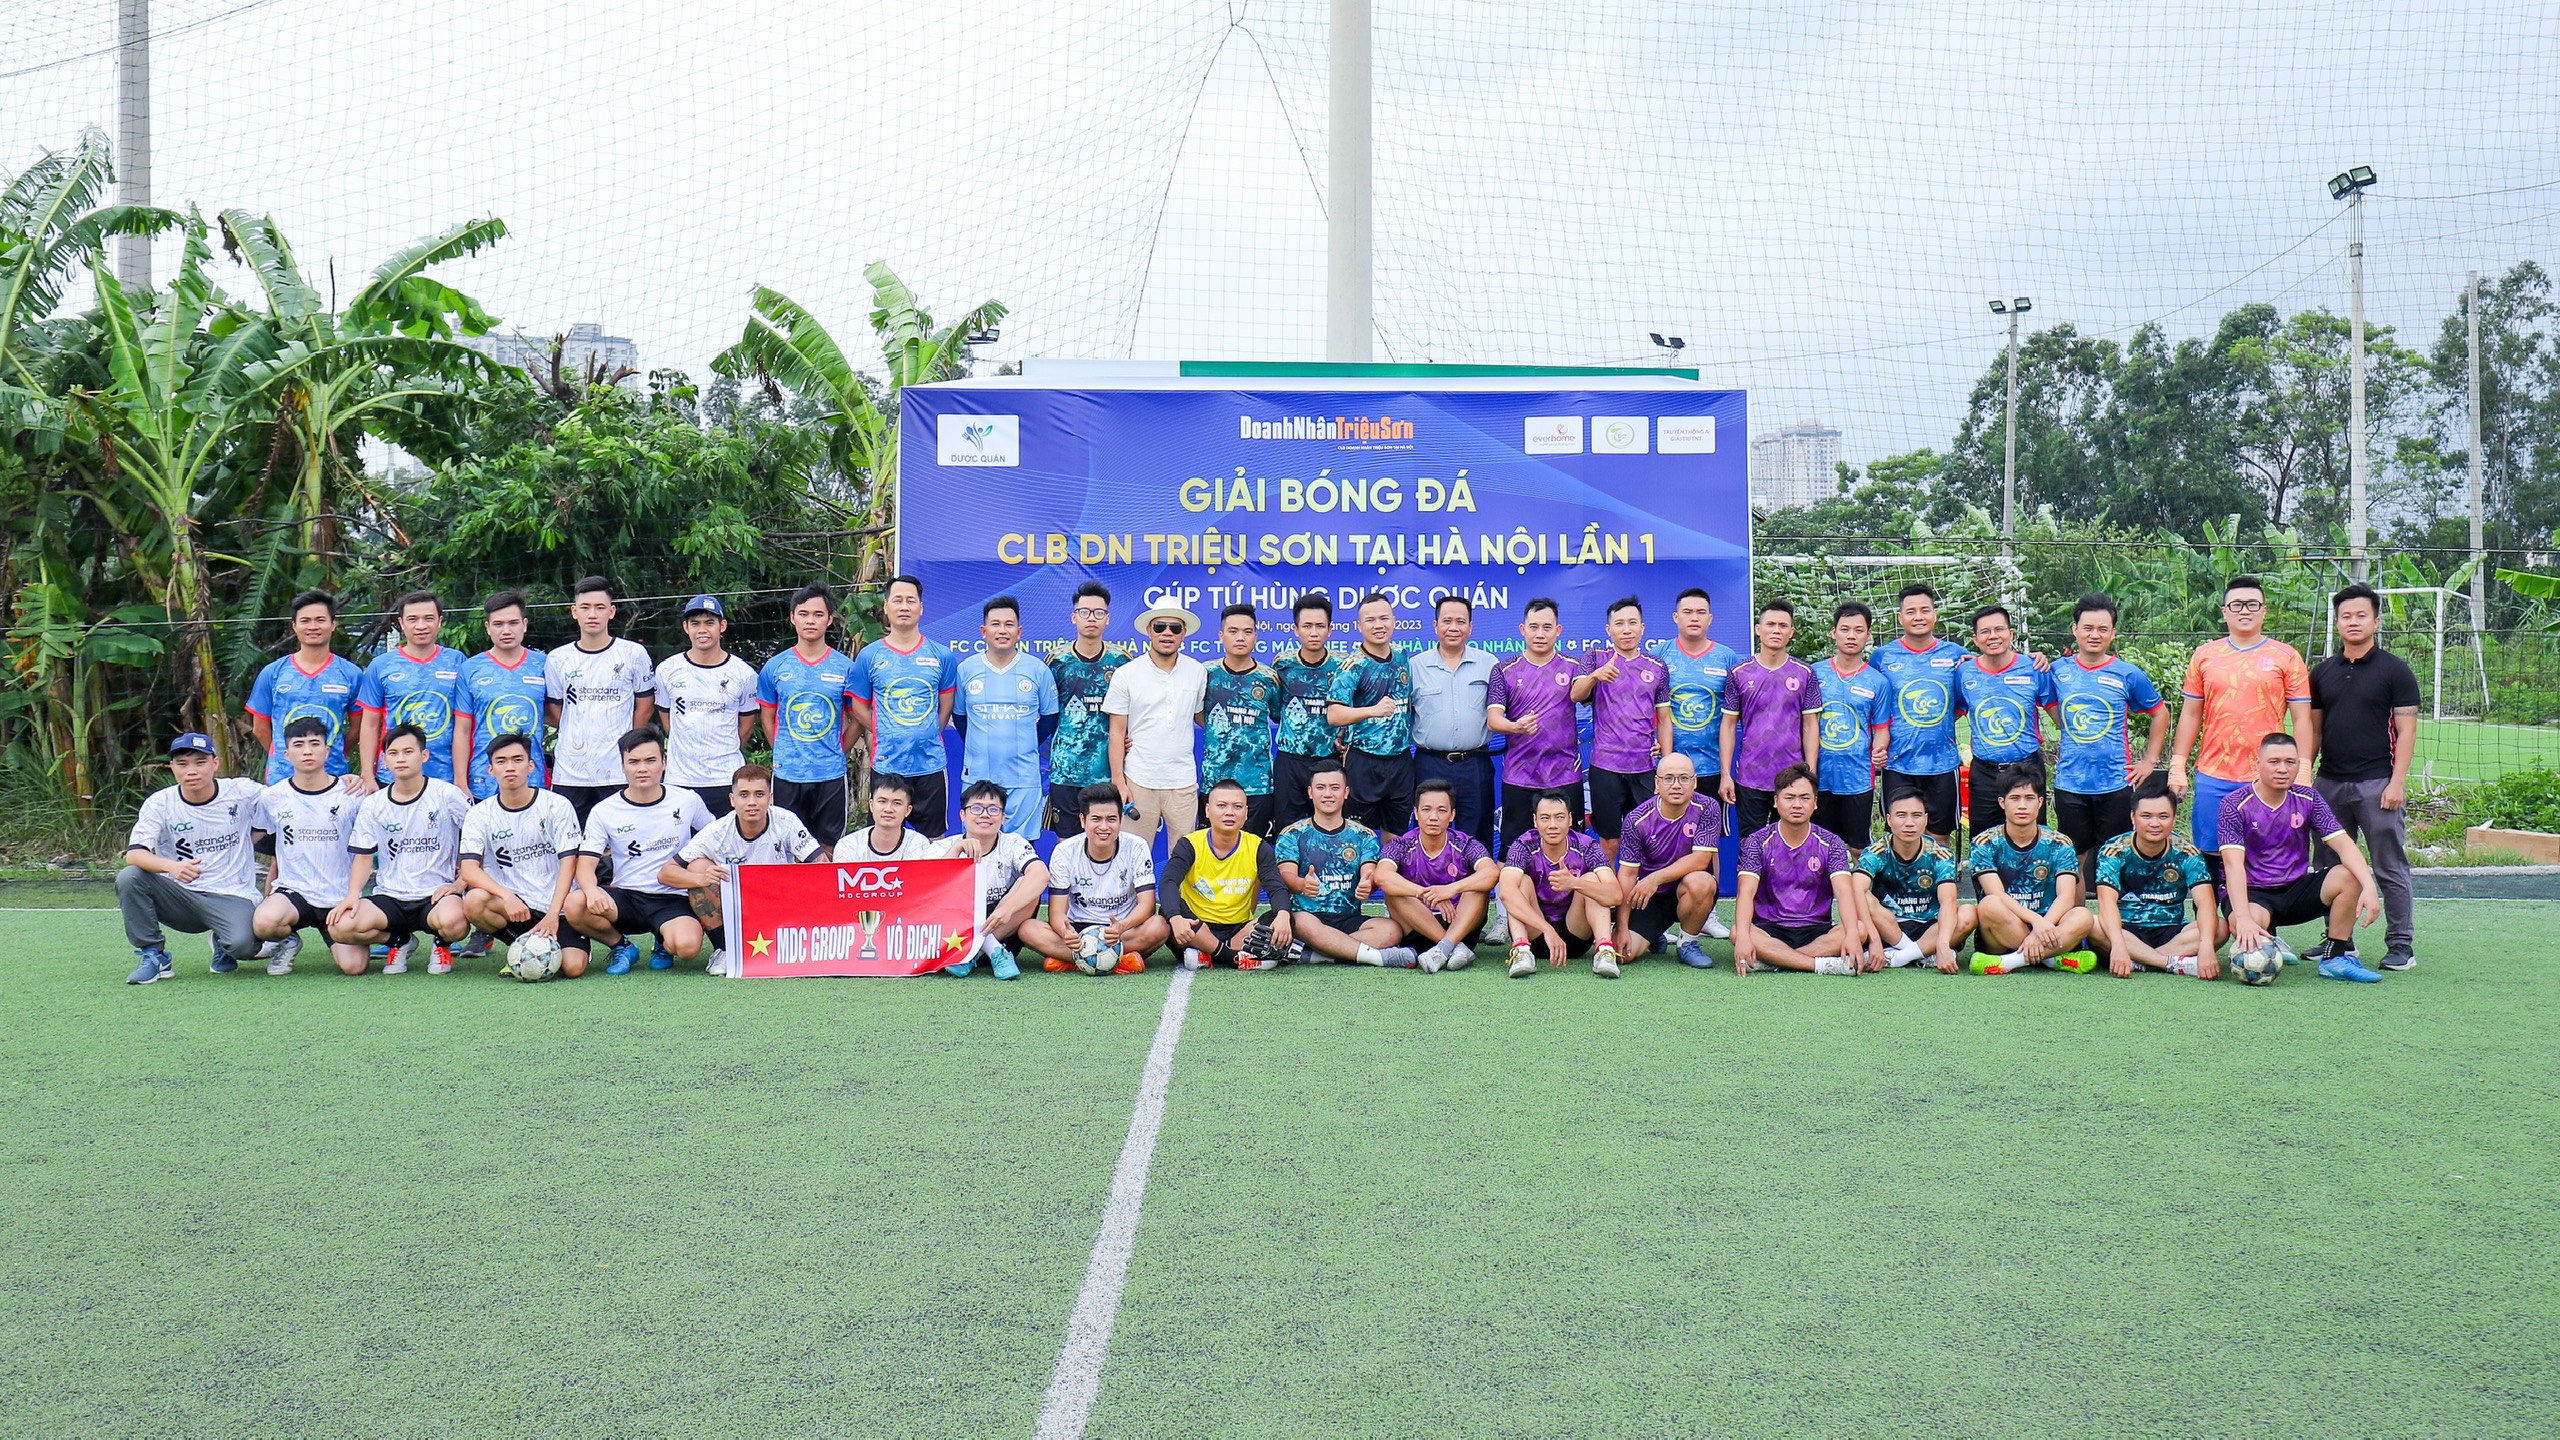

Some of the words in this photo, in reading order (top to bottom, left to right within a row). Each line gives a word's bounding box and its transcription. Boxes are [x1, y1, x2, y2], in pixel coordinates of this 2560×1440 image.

[1532, 434, 1576, 443] everhome
[1178, 466, 1267, 513] GIẢI
[1279, 468, 1403, 513] BÓNG
[1415, 468, 1478, 513] ĐÁ
[996, 532, 1068, 565] CLB
[1080, 532, 1133, 565] DN
[1143, 526, 1247, 576] TRIỆU
[1258, 531, 1338, 566] SƠN
[1348, 533, 1406, 575] TẠI
[1417, 526, 1469, 566] HÀ
[1480, 525, 1548, 576] NỘI
[1559, 521, 1629, 565] LẦN
[1639, 532, 1655, 565] 1
[1206, 580, 1245, 609] TỨ
[950, 640, 970, 653] FC
[1190, 640, 1209, 653] FC
[1582, 639, 1601, 653] FC
[578, 686, 619, 695] standard
[578, 694, 621, 702] chartered
[689, 700, 726, 708] standard
[971, 703, 1030, 713] ETIHAD
[981, 713, 1021, 721] AIRWAYS
[298, 827, 338, 835] standard
[194, 831, 239, 848] standard
[298, 834, 340, 842] chartered
[398, 836, 438, 847] andard
[646, 836, 680, 848] standard
[195, 837, 241, 855] chartered
[837, 866, 903, 892] MDC
[838, 891, 904, 899] MDCGROUP
[776, 926, 807, 964] MDC
[810, 925, 855, 961] GROUP
[886, 917, 903, 961] VÔ
[906, 924, 942, 969] ĐỊCH!
